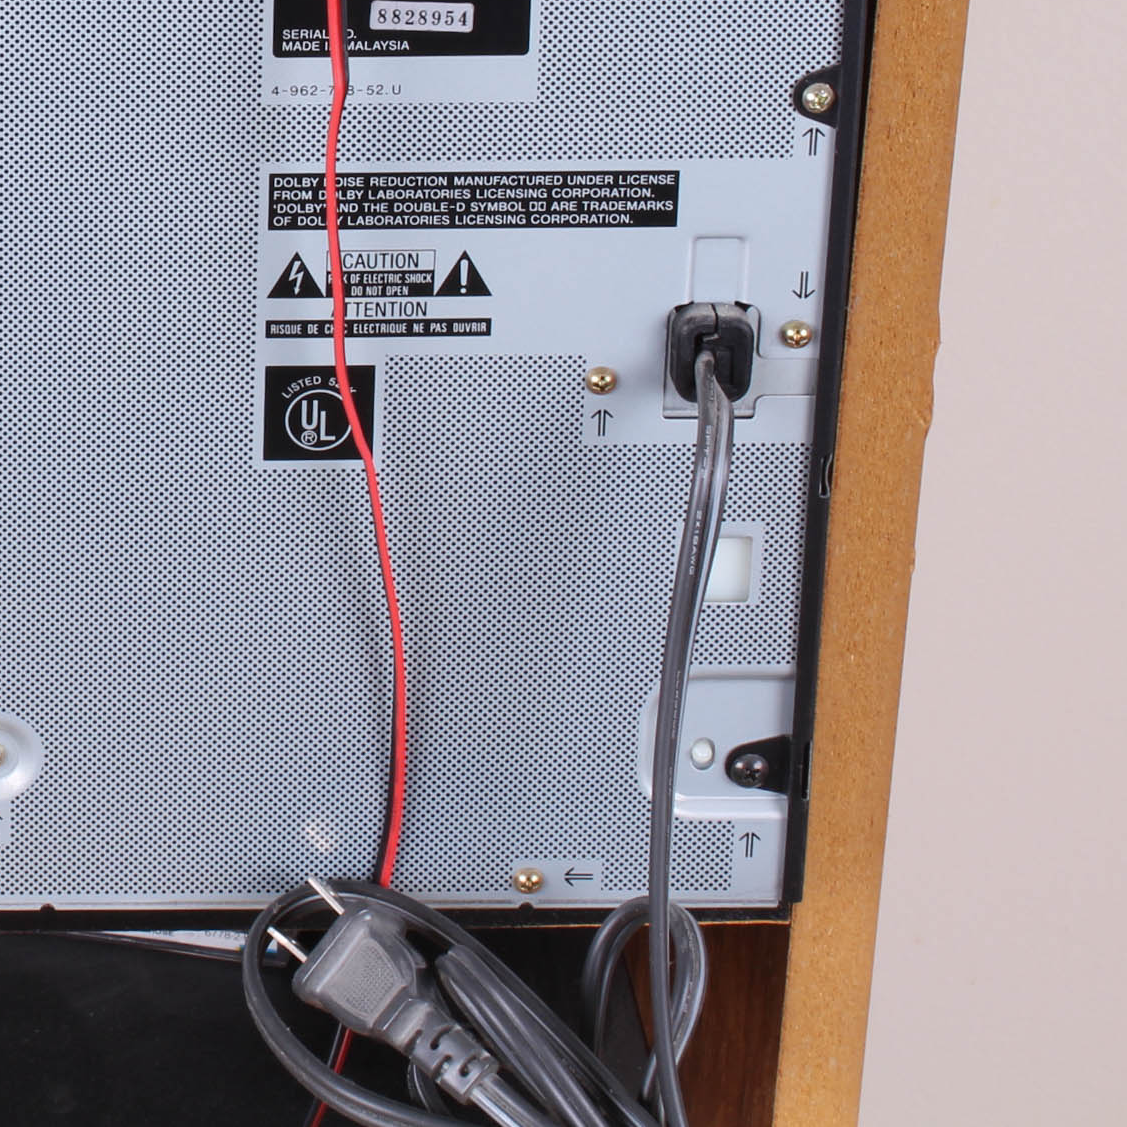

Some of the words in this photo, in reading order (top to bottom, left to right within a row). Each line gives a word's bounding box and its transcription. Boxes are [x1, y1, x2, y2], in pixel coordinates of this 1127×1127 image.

[377, 9, 468, 26] 8828954
[282, 29, 329, 39] SERIAL
[282, 41, 320, 51] MADE
[271, 85, 401, 96] 4-962-7-52.U
[274, 178, 319, 188] DOLBY
[324, 177, 364, 187] OISE
[370, 177, 448, 187] REDUCTION
[453, 176, 562, 186] MANUFACTURED
[568, 175, 613, 185] UNDER
[619, 175, 675, 185] LICENSE
[274, 191, 312, 200] FROM
[319, 190, 363, 200] DLBY
[369, 189, 471, 200] LABORATORIES
[476, 189, 547, 199] LICENSING
[552, 188, 654, 198] CORPORATION.
[363, 203, 388, 212] THE
[394, 202, 465, 212] DOUBLE-D
[471, 202, 525, 211] SYMBOL
[551, 201, 577, 211] ARE
[582, 201, 673, 210] TRADEMARKS
[274, 217, 291, 226] OF
[298, 216, 344, 226] DOLY
[348, 215, 450, 225] LABORATORIES
[455, 214, 526, 224] LICENSING
[531, 214, 633, 224] CORPORATION.
[343, 253, 419, 269] CAUTION
[351, 274, 361, 283] OF
[364, 274, 401, 283] ELECTRIC
[404, 273, 432, 283] SHOCK
[351, 286, 362, 296] DO
[366, 286, 383, 296] NOT
[386, 286, 408, 296] OPEN
[271, 324, 302, 335] RISQUE
[308, 324, 319, 334] DE
[354, 323, 407, 333] ELECTRIQUE
[413, 323, 424, 333] NE
[430, 322, 447, 332] PAS
[453, 322, 486, 332] OUVRIR
[282, 376, 321, 398] LISTED
[301, 400, 336, 440] UL
